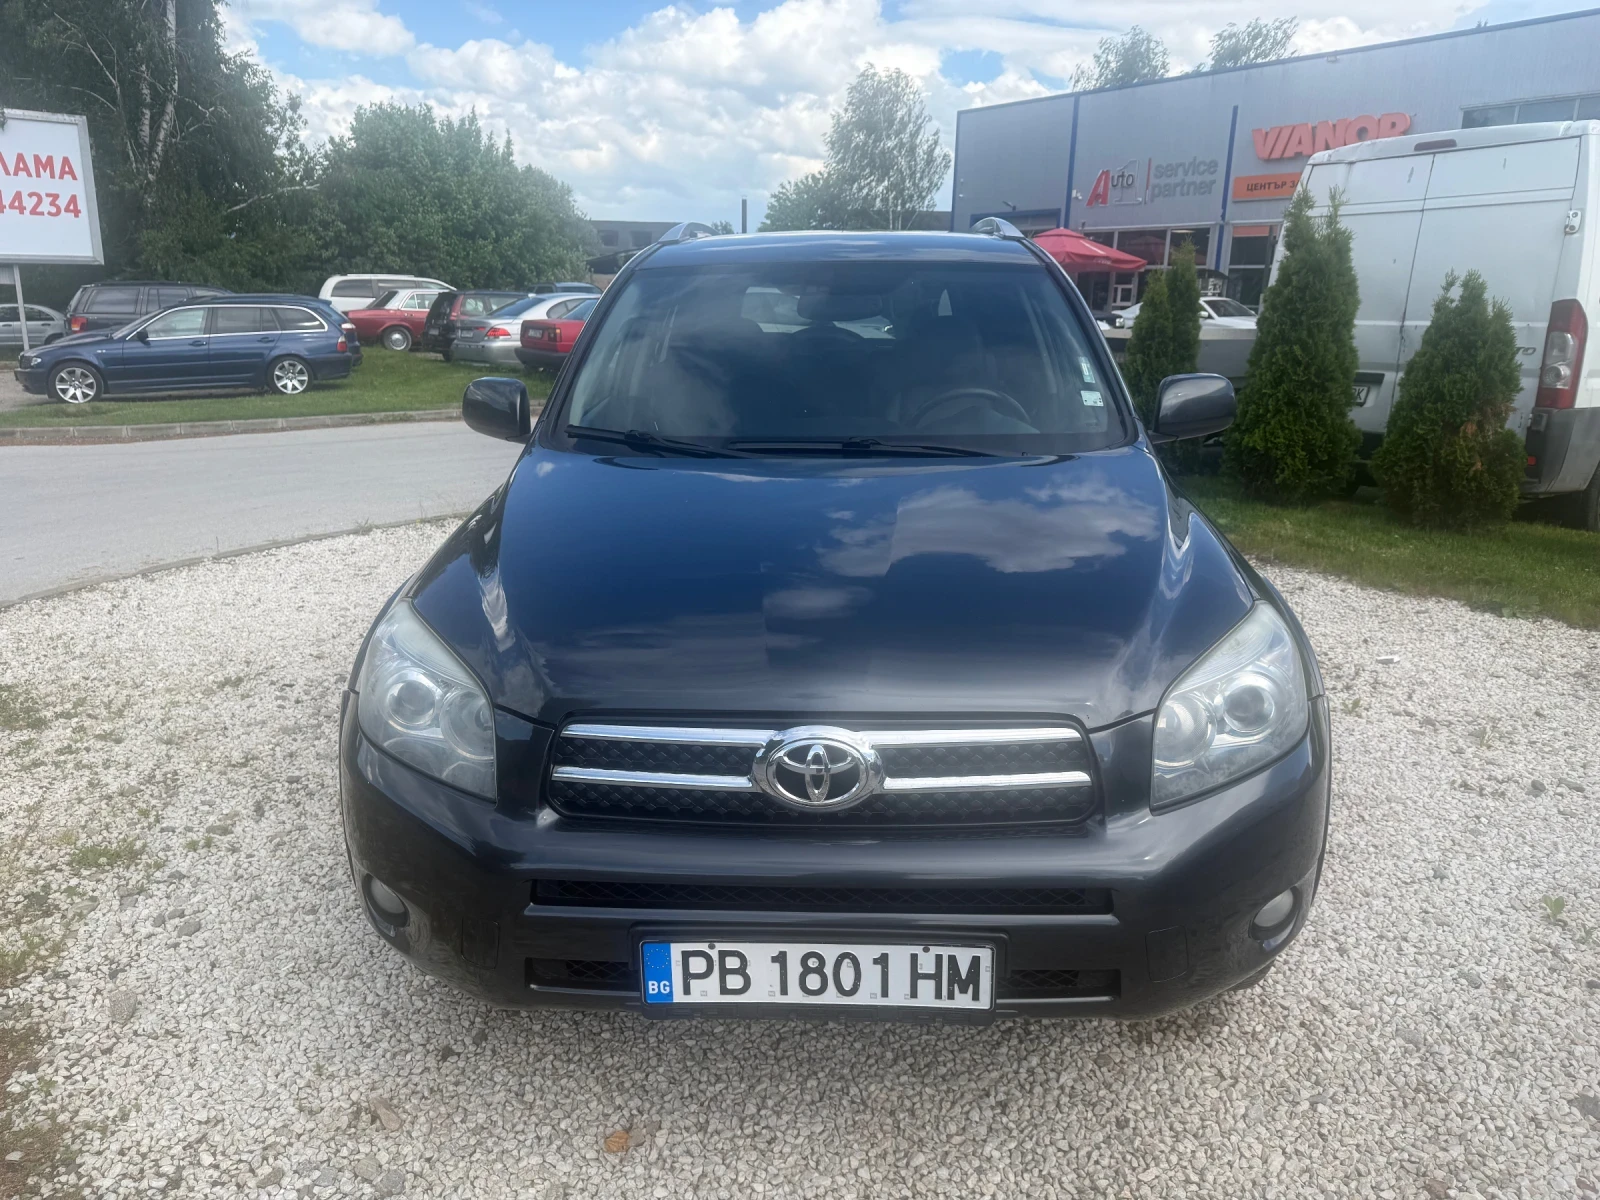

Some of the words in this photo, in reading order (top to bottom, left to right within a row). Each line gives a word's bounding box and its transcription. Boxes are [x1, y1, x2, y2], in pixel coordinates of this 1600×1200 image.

[1252, 112, 1410, 160] VIANOR
[1154, 156, 1219, 179] service
[1150, 178, 1217, 203] partner
[1246, 181, 1287, 192] ЦЕНТЪР
[1289, 180, 1300, 189] З
[648, 980, 670, 994] BG
[681, 950, 751, 996] PB
[771, 950, 889, 998] 1801
[910, 952, 981, 1001] HM
